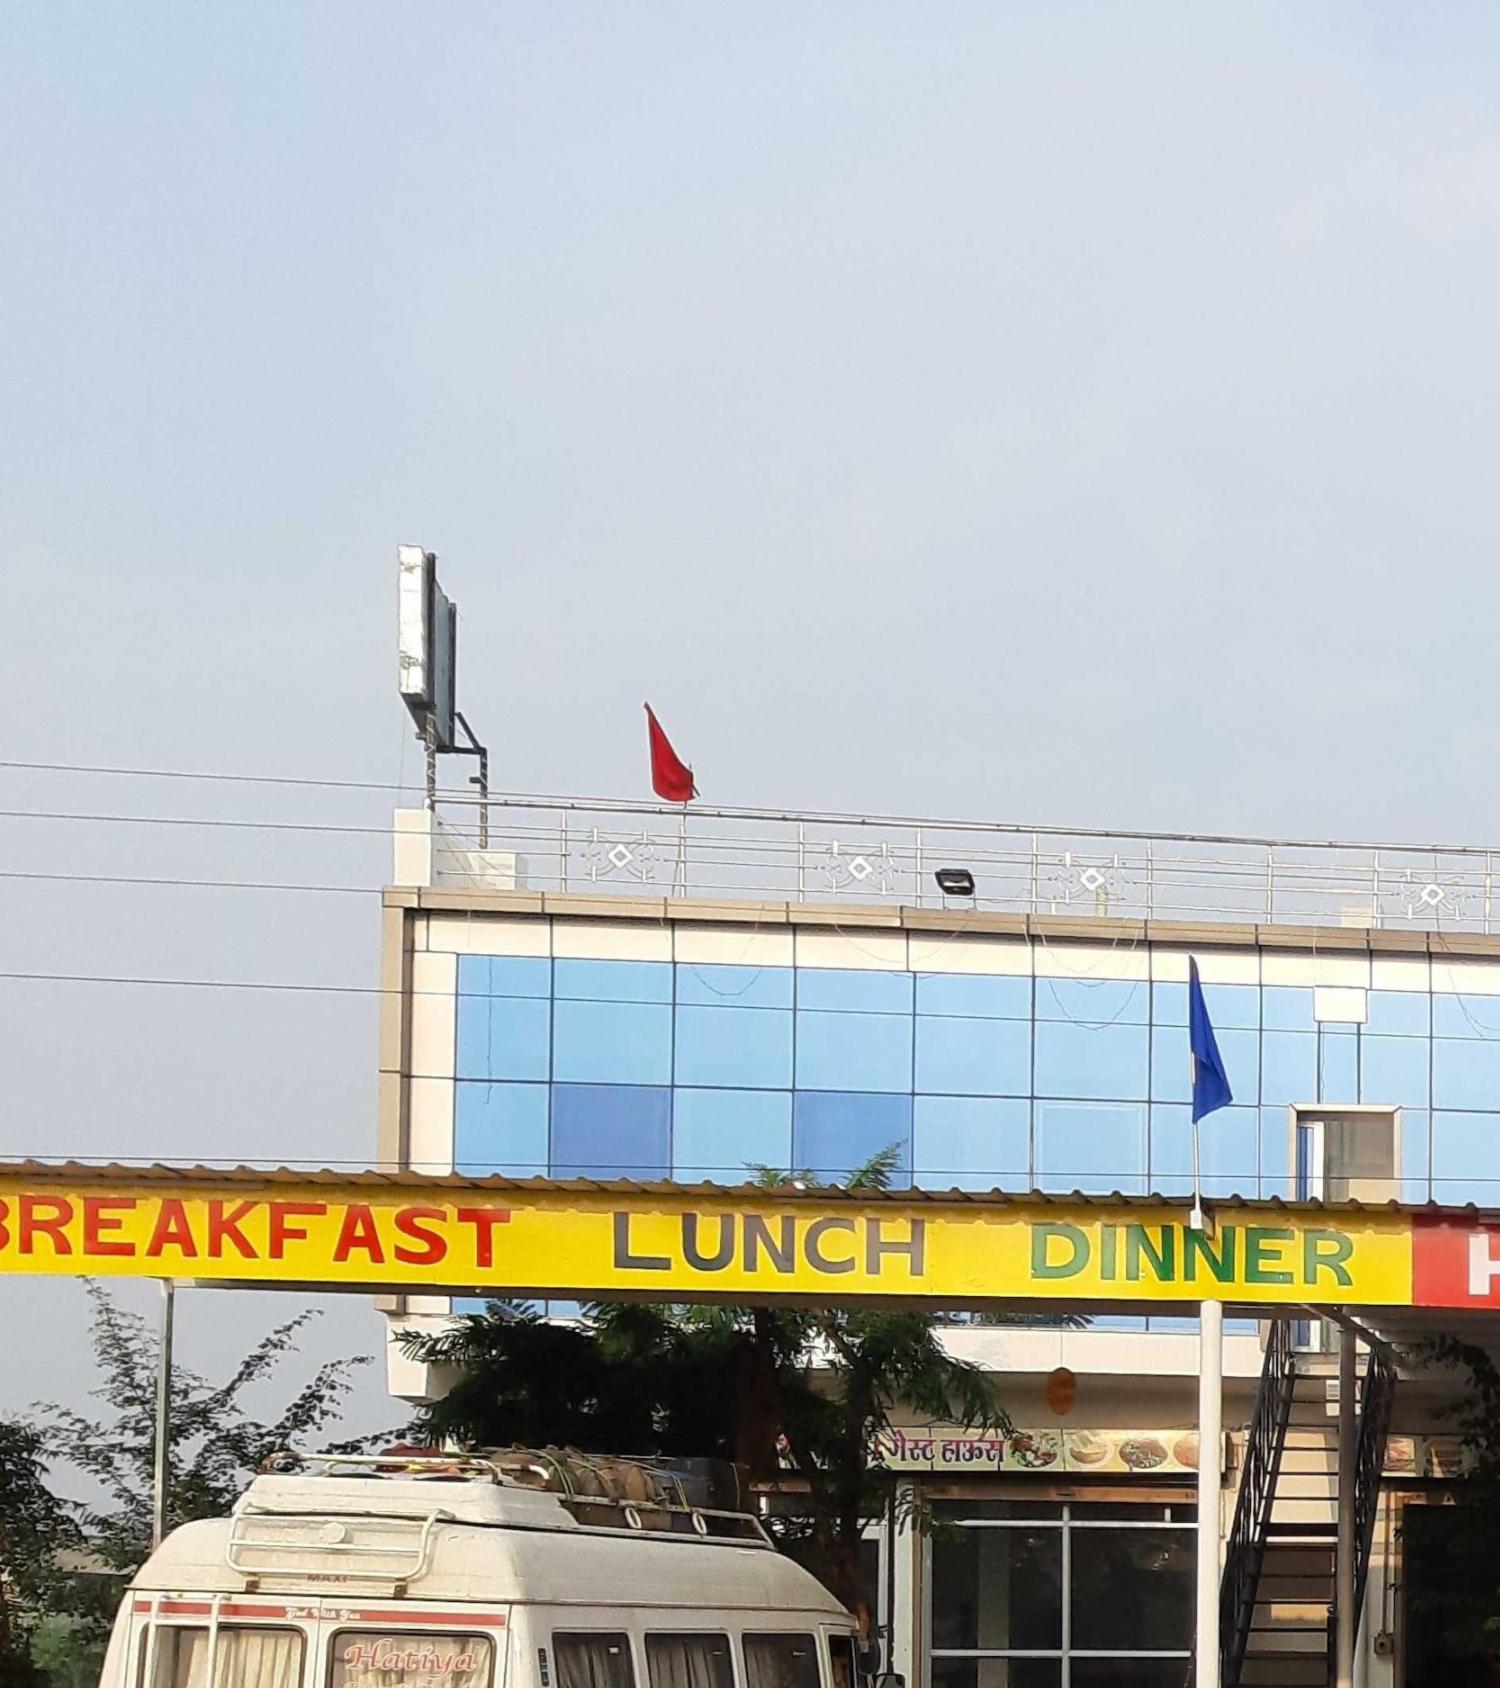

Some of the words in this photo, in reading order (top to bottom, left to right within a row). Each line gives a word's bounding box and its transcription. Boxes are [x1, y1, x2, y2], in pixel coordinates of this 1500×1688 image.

[0, 1194, 512, 1268] REAKFAST
[612, 1211, 925, 1277] LUNCH
[1030, 1222, 1354, 1288] DINNER
[343, 1637, 476, 1680] Hatiya
